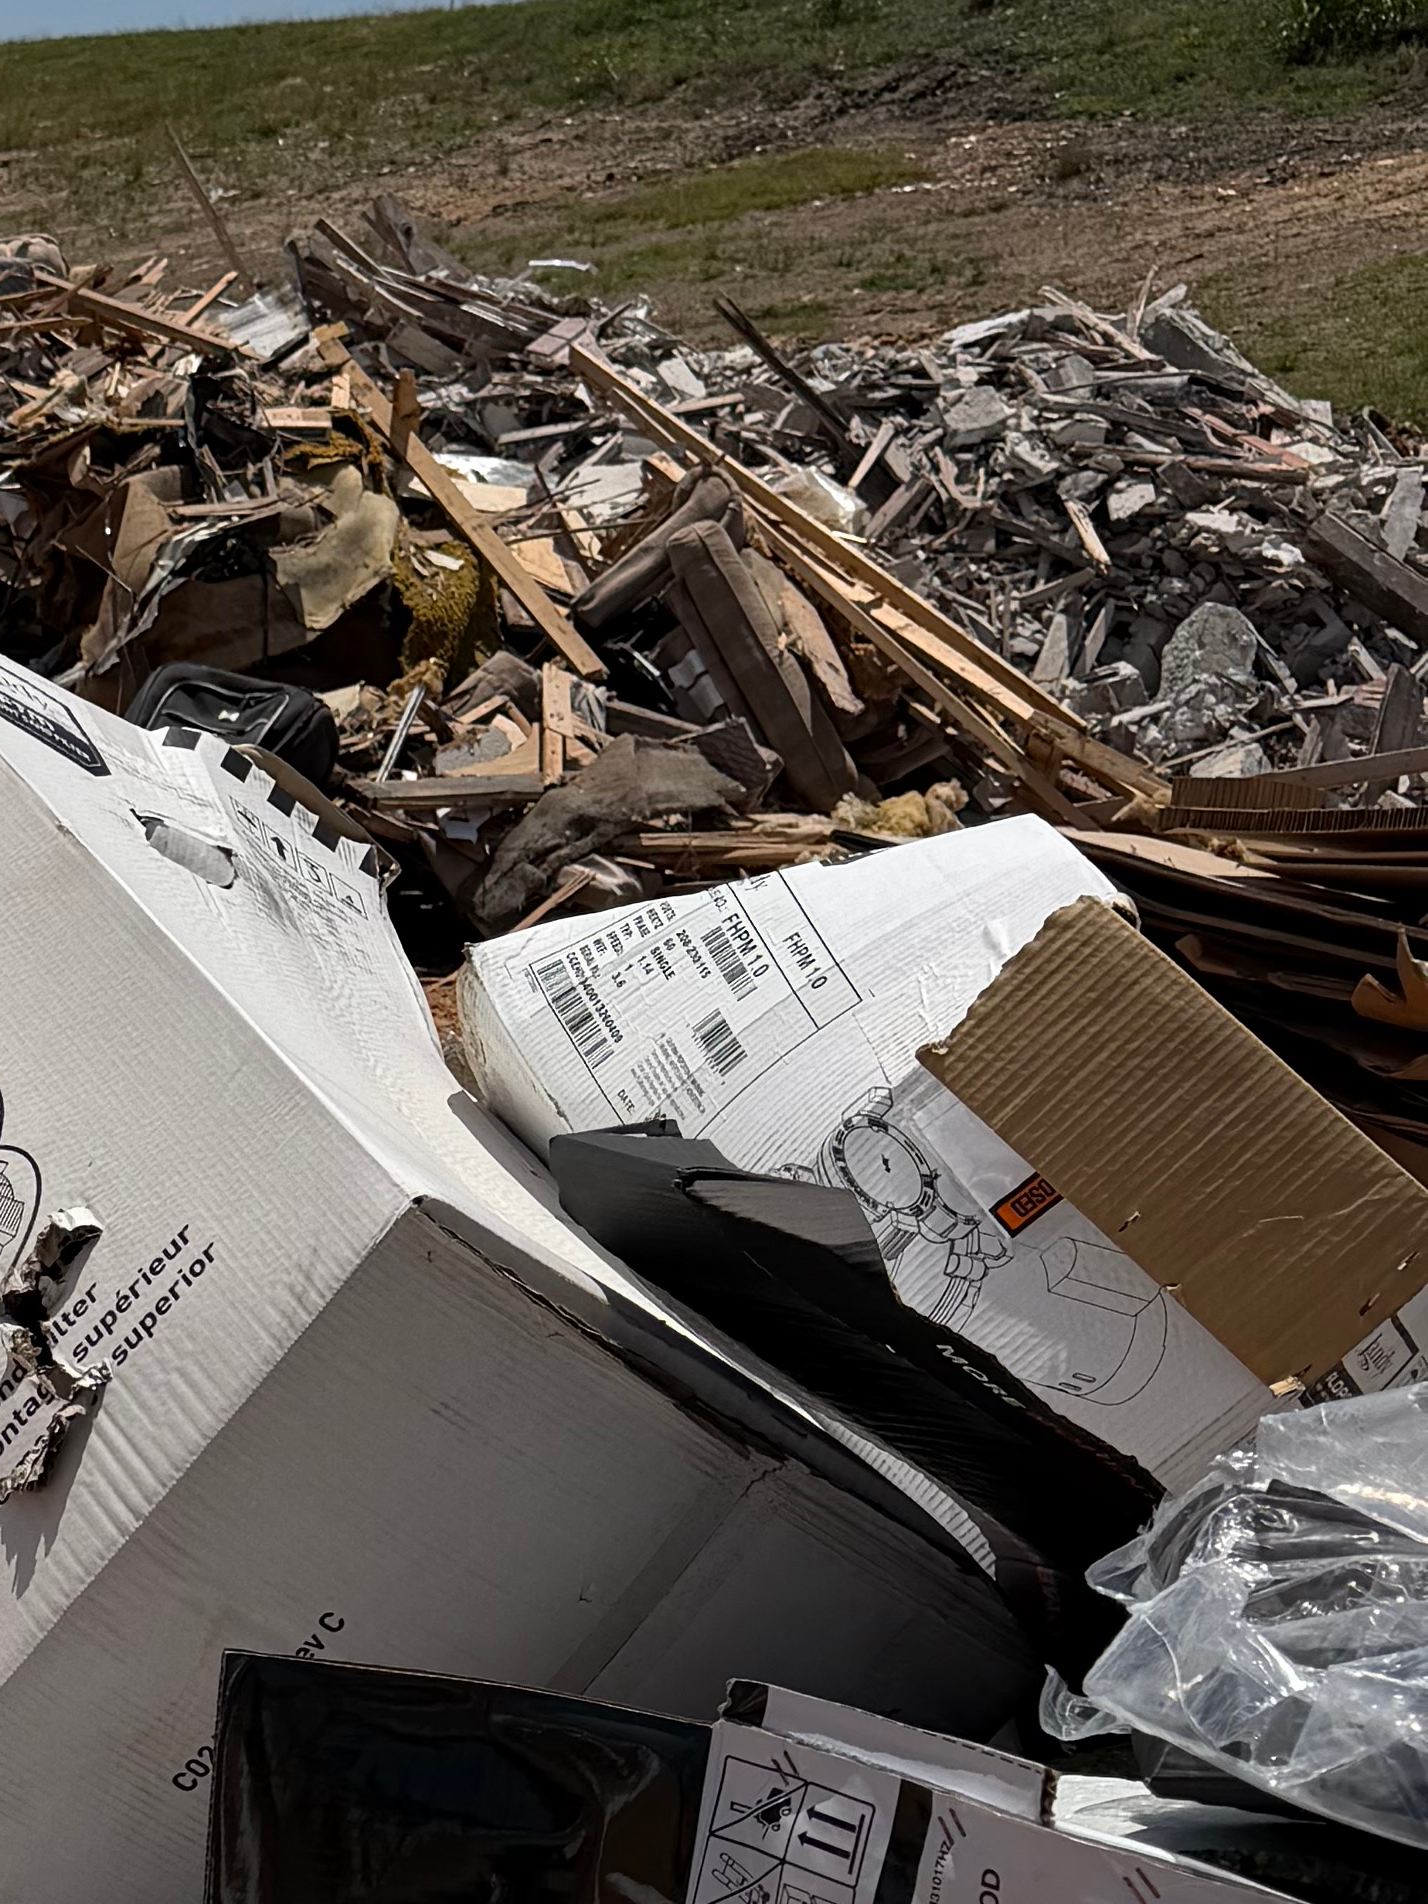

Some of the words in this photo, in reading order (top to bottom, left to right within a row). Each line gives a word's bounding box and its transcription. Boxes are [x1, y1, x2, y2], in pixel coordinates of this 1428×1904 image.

[650, 946, 676, 981] SINGLE
[722, 913, 757, 956] FHPM
[747, 954, 770, 977] 1.0
[782, 932, 816, 970] FHPM
[805, 967, 828, 989] 1.0
[39, 1275, 108, 1349] ilter
[62, 1216, 201, 1367] supérieur
[101, 1235, 227, 1371] superior
[315, 1605, 348, 1638] C
